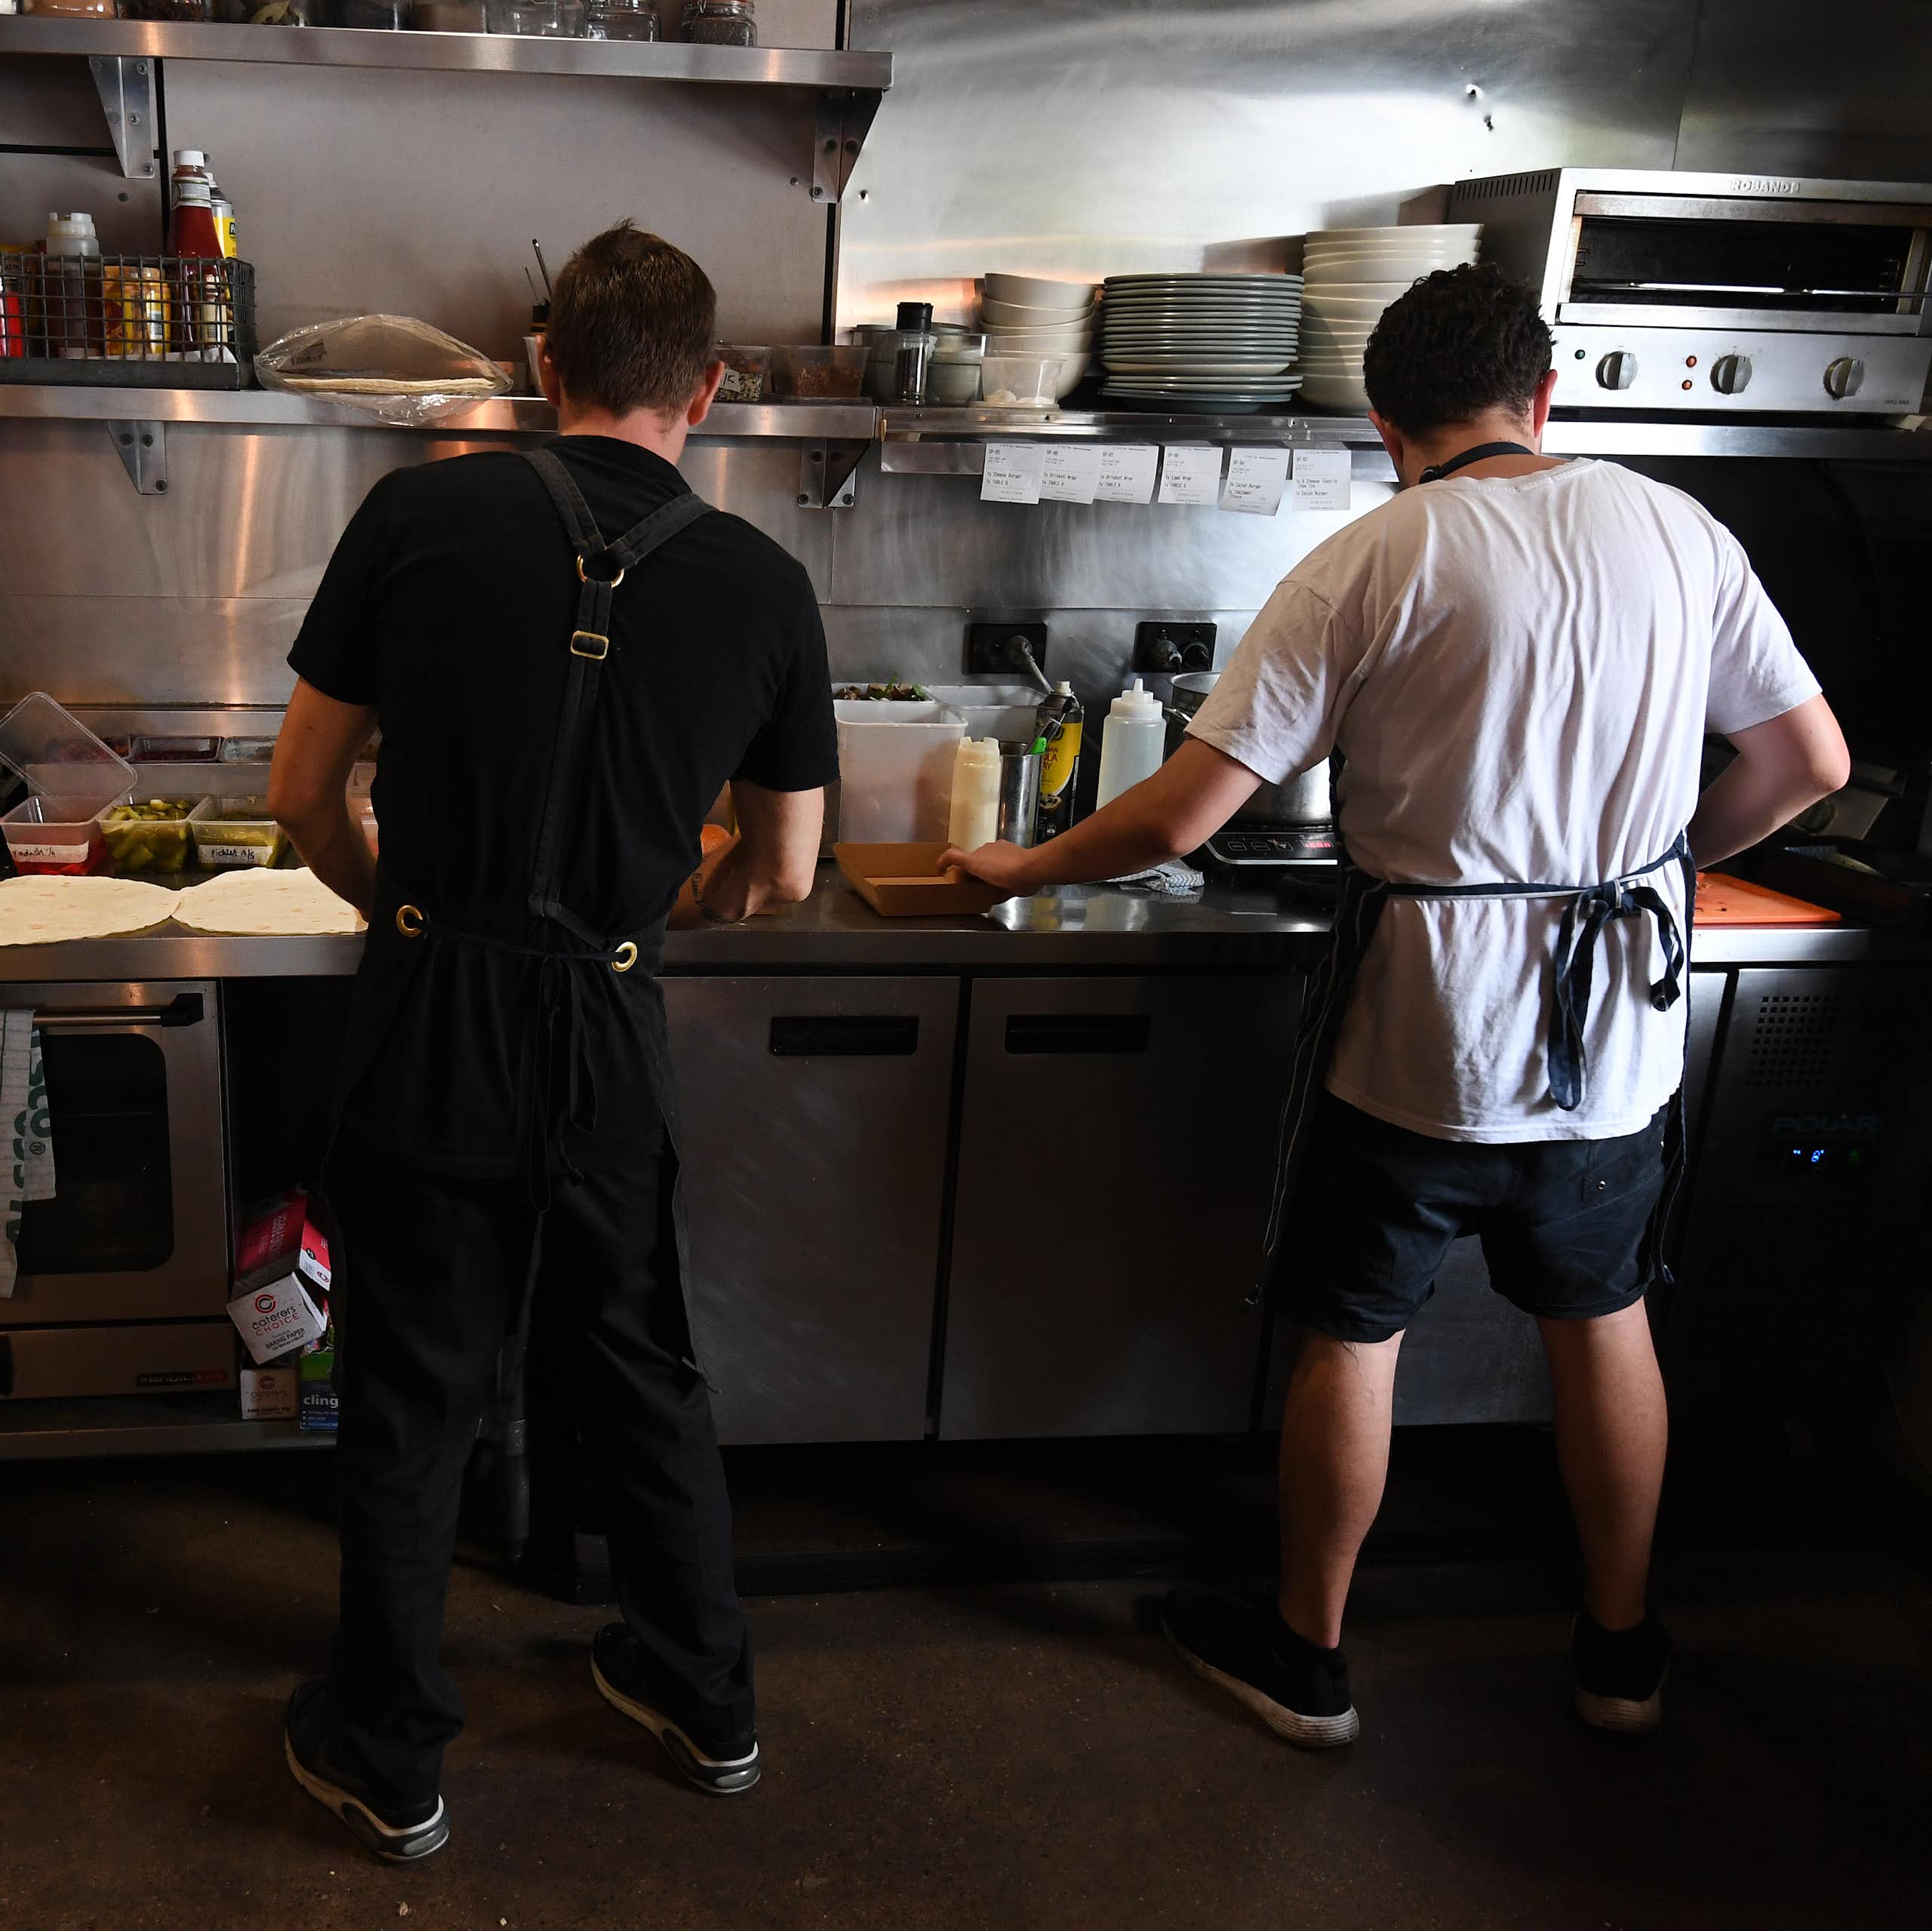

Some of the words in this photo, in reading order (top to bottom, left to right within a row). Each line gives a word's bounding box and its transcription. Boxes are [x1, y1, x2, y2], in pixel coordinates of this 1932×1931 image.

[252, 1305, 296, 1330] caterers
[256, 1312, 300, 1336] CHOICE
[303, 1394, 339, 1409] cling
